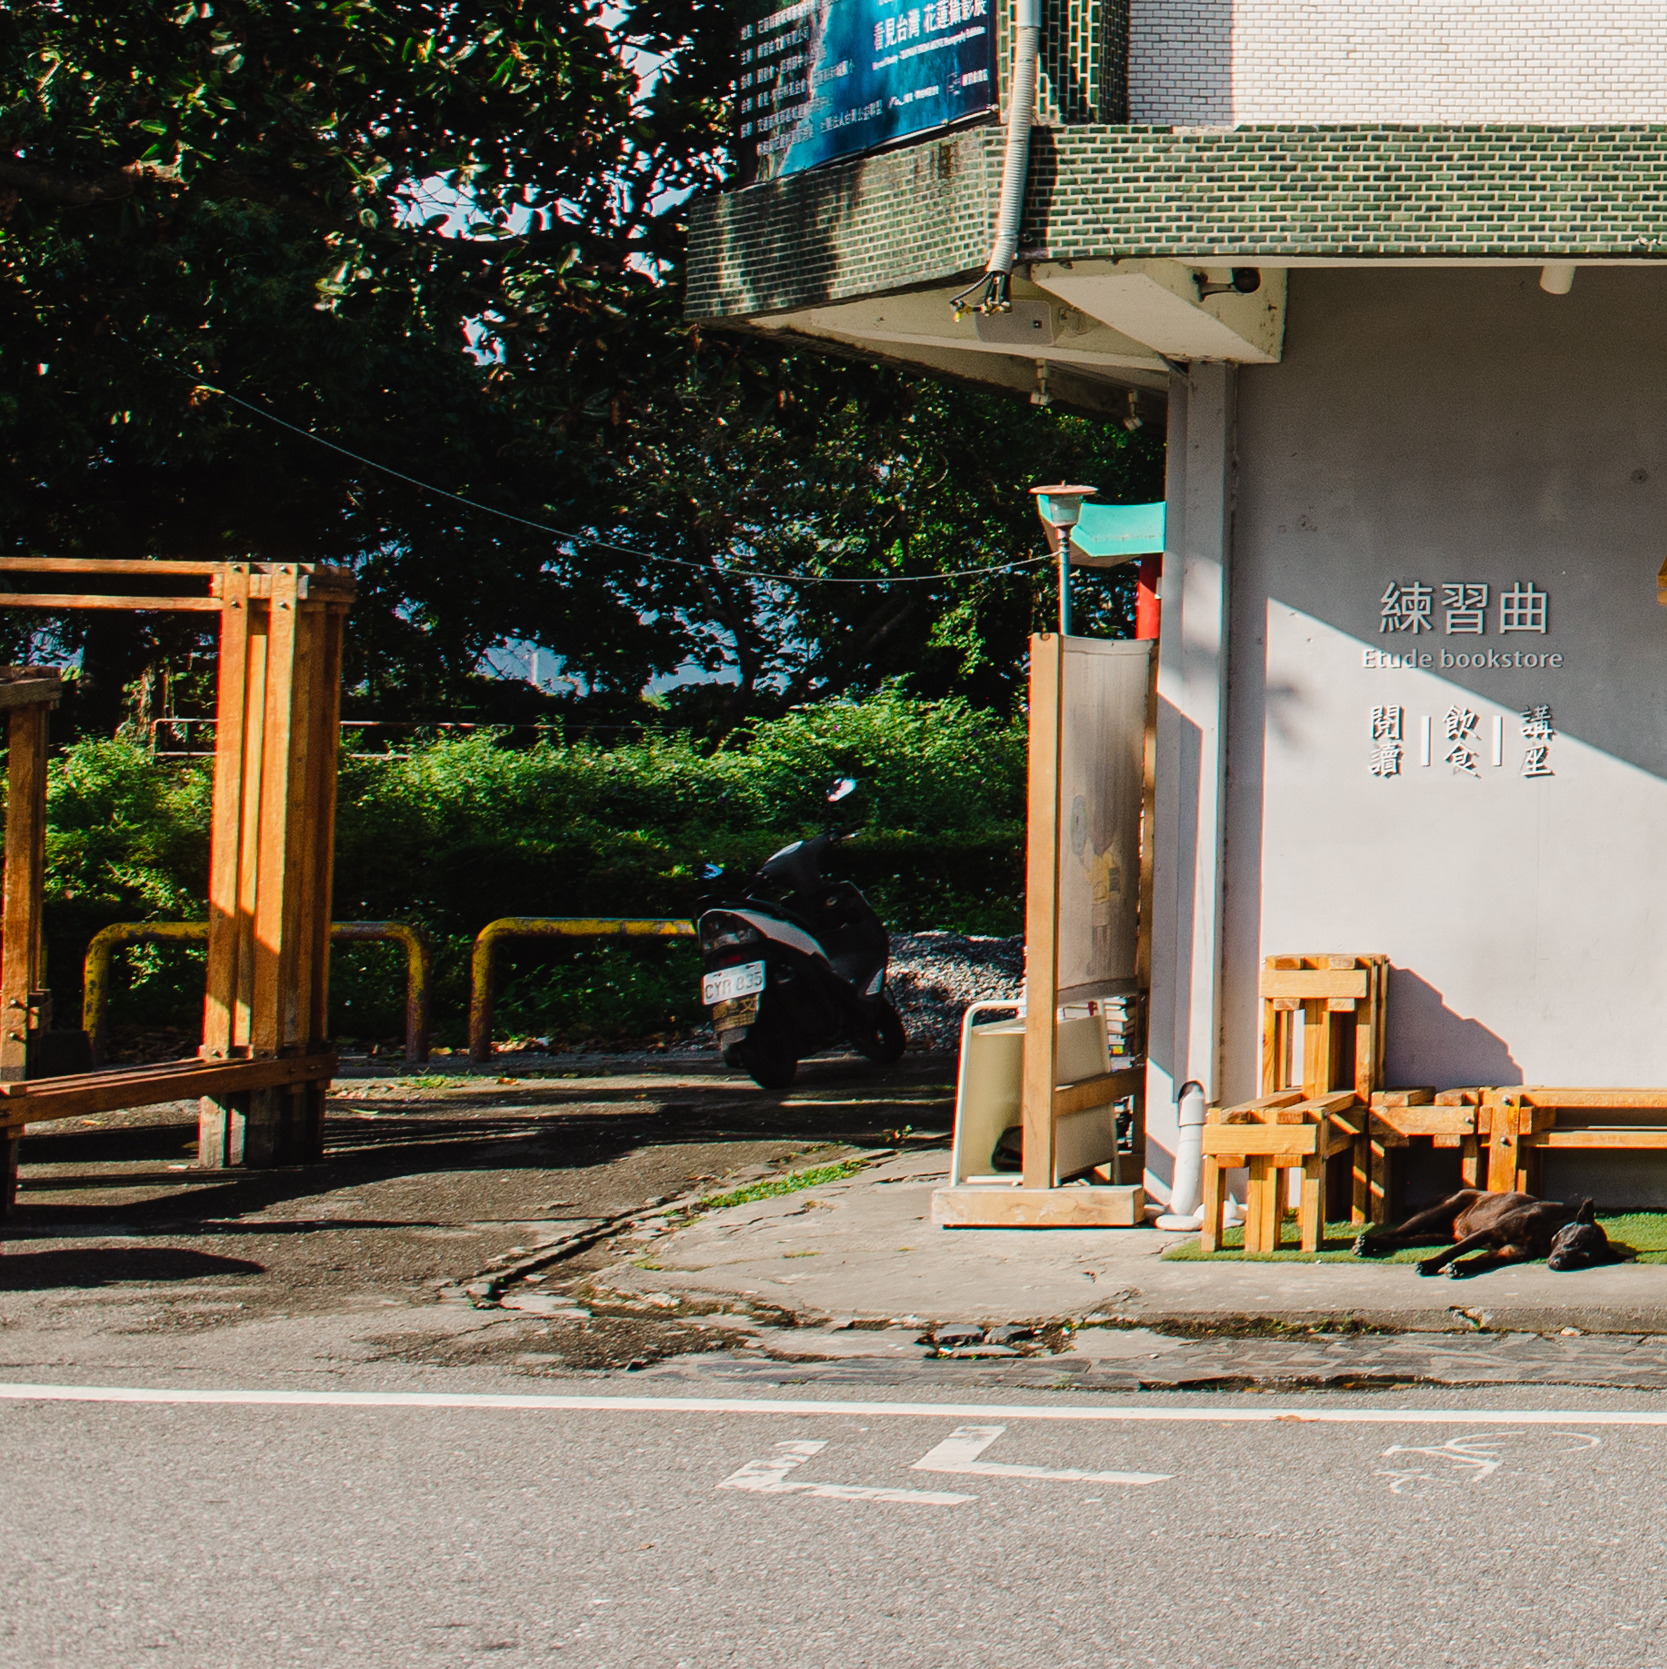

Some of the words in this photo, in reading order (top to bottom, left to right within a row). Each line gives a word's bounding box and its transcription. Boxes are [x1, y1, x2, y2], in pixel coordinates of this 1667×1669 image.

[873, 8, 920, 51] 看見台灣
[1379, 581, 1549, 635] 練習曲
[1362, 648, 1434, 669] Etude
[1440, 647, 1564, 669] bookstore
[1368, 704, 1405, 778] 閱讀
[1443, 704, 1482, 779] 飲食
[1519, 704, 1557, 778] 講座
